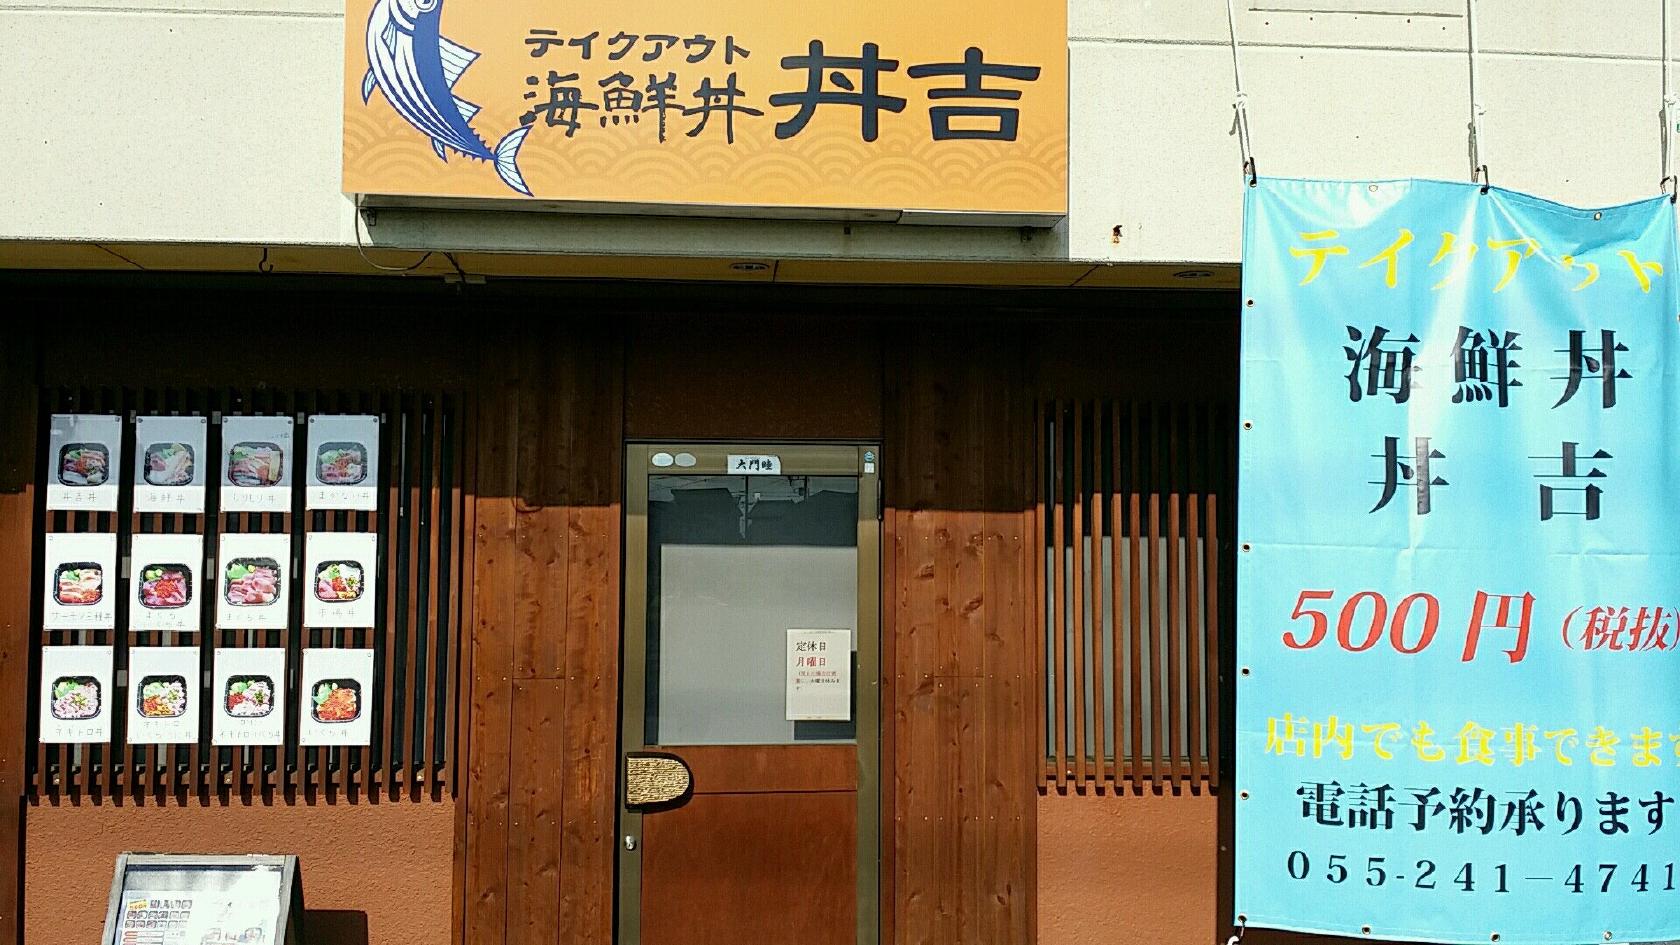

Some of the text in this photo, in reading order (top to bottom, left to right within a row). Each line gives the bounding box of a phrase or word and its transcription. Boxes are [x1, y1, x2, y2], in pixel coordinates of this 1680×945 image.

[525, 29, 750, 64] テイクアウト
[519, 71, 764, 144] 海鮮丼
[769, 39, 1042, 143] 丼吉
[1289, 228, 1665, 293] テイクアウト
[1343, 325, 1633, 410] 海鮮丼
[796, 641, 826, 652] 定休日
[796, 657, 826, 667] 月曜日
[1296, 780, 1676, 837] 電話予約承ります
